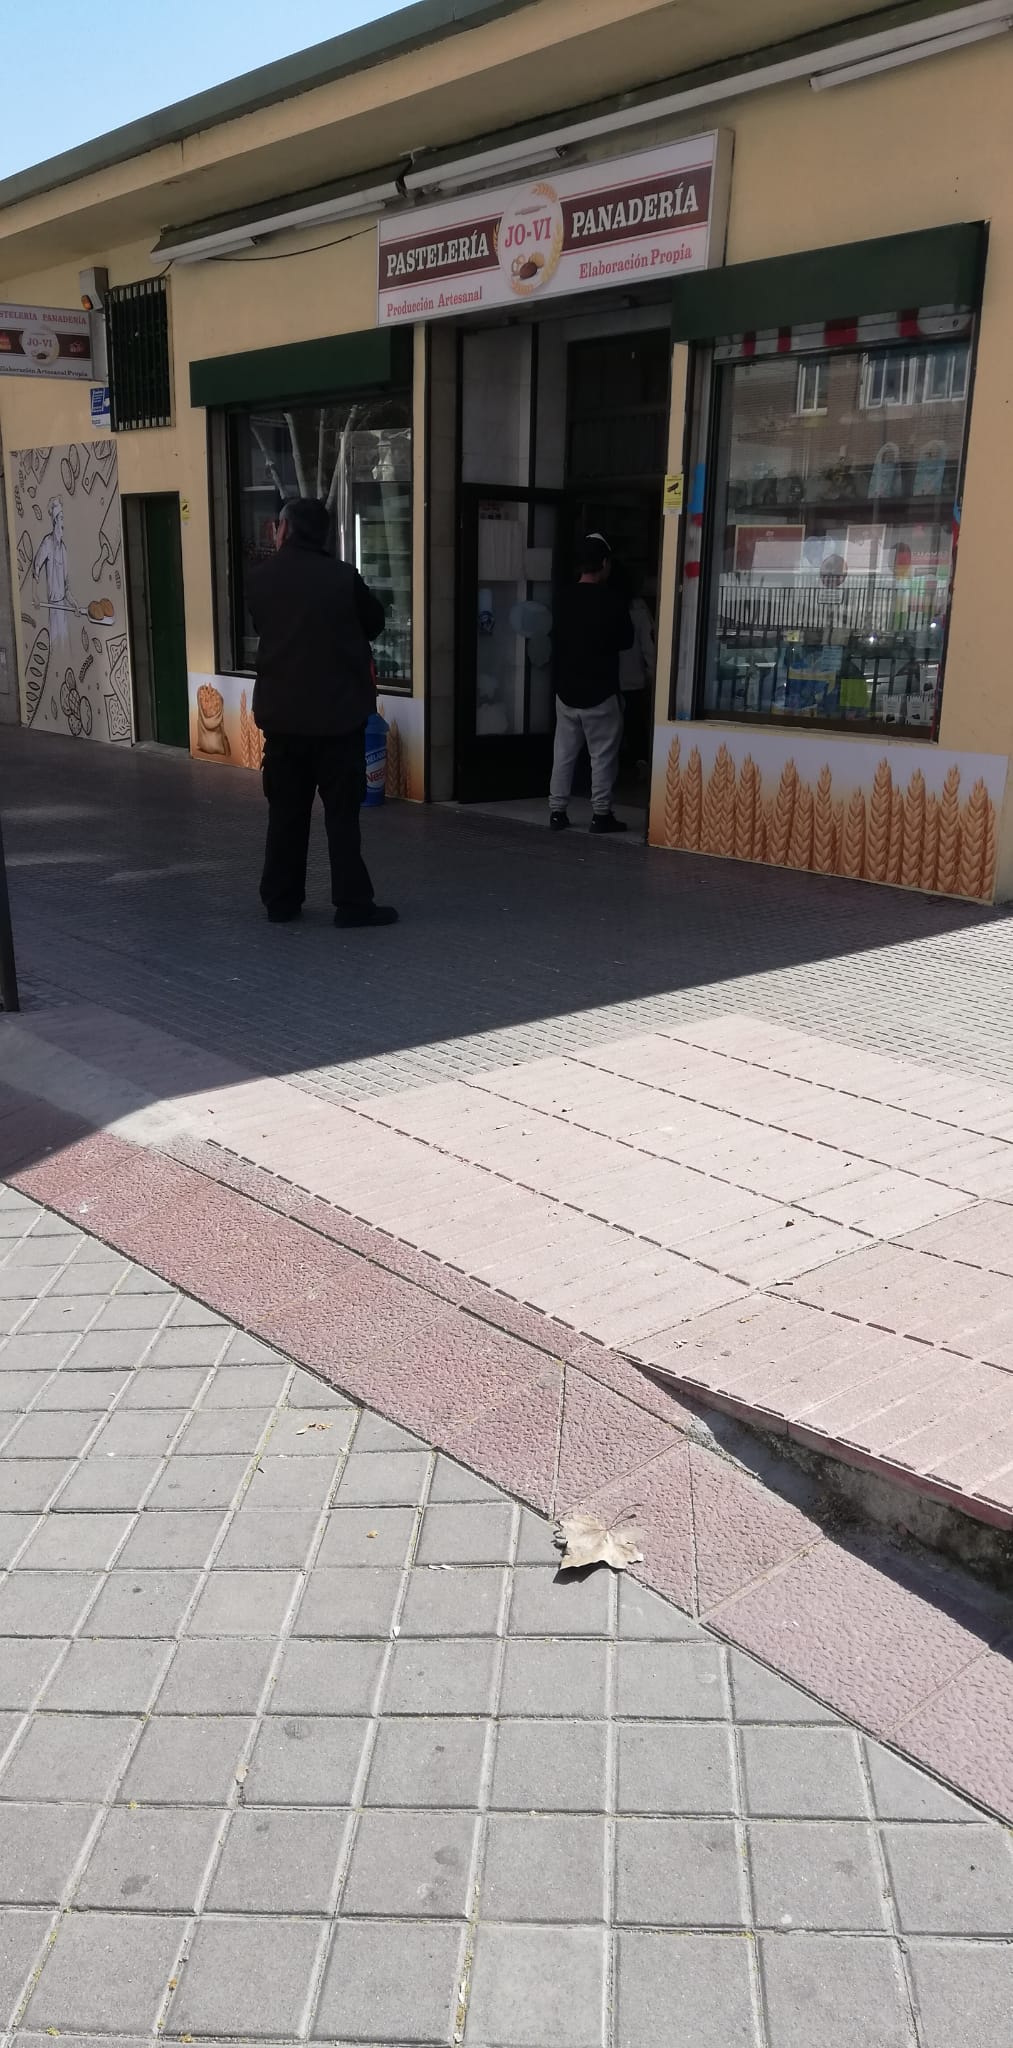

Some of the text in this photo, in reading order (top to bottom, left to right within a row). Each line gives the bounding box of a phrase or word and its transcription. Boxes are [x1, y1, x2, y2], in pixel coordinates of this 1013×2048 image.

[571, 182, 699, 239] PANADERÍA
[504, 216, 552, 249] JO-VI
[386, 229, 490, 278] PASTELERÍA
[578, 243, 693, 280] Elaboración Propia
[386, 286, 483, 318] Producción Artesanal
[27, 338, 53, 348] JO-VI
[36, 368, 67, 376] Artesanal
[67, 369, 88, 378] Propia
